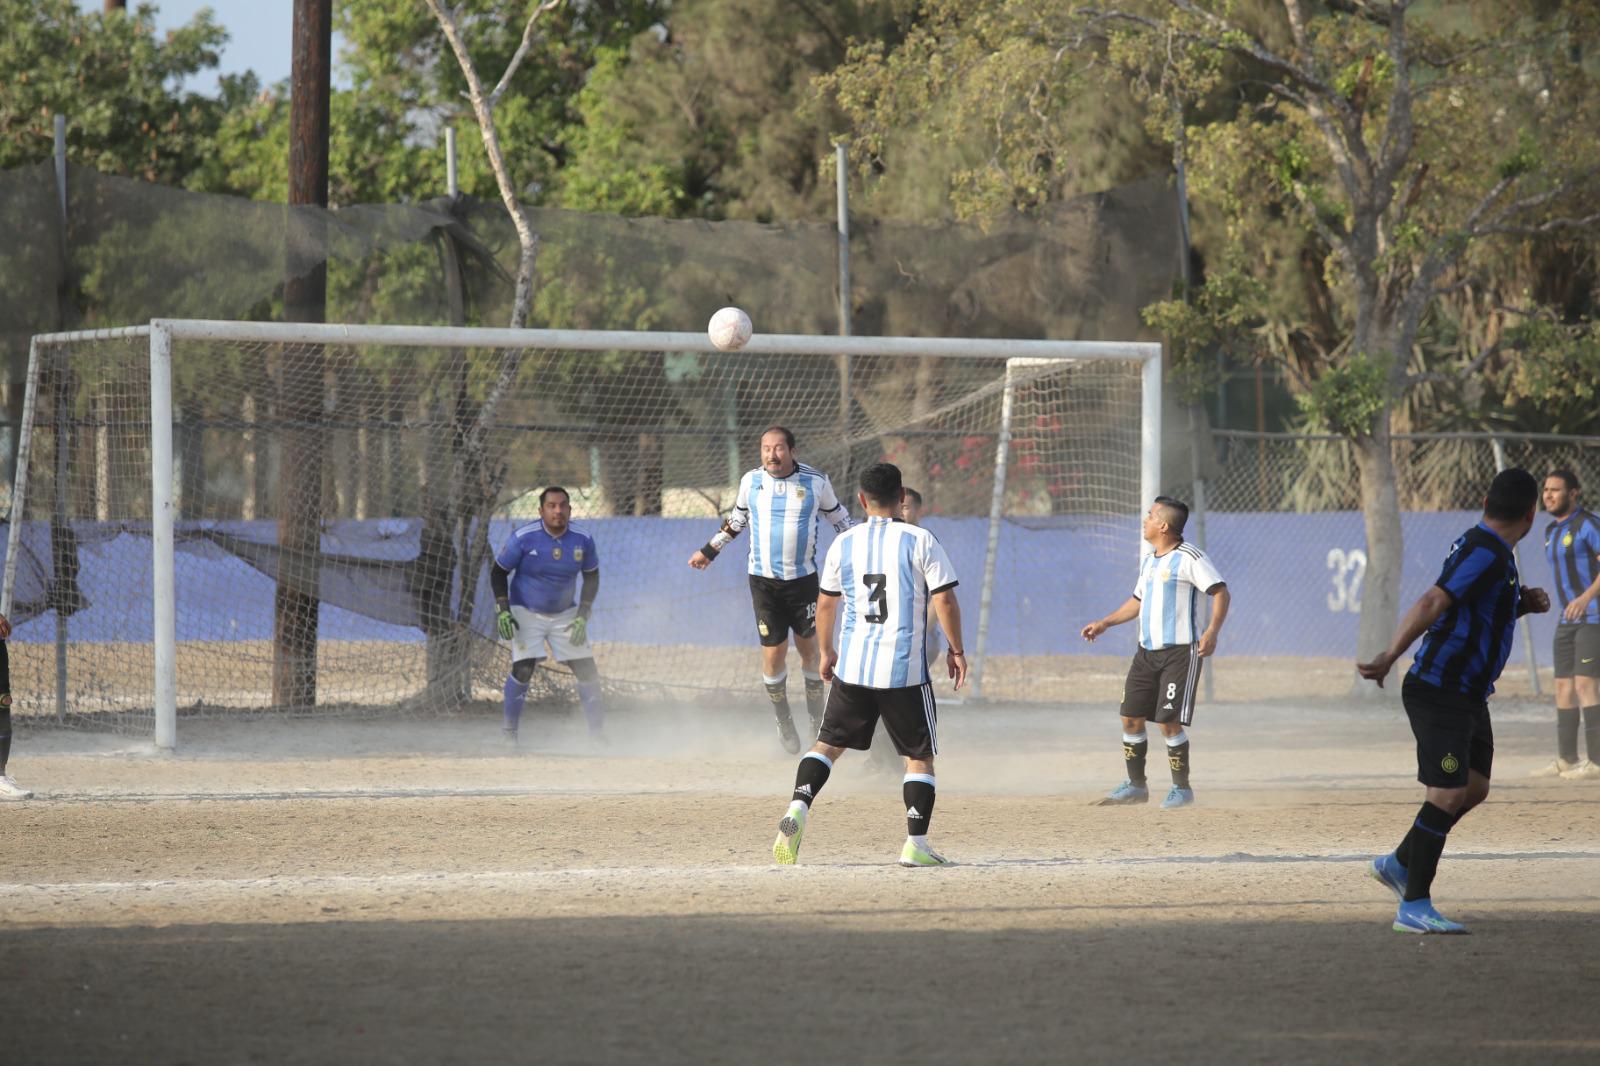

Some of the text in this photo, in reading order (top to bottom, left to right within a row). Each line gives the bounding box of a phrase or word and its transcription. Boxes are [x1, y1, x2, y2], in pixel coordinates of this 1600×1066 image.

[1327, 548, 1367, 613] 32
[806, 602, 817, 619] 18
[863, 574, 888, 624] 3
[1166, 682, 1177, 700] 8
